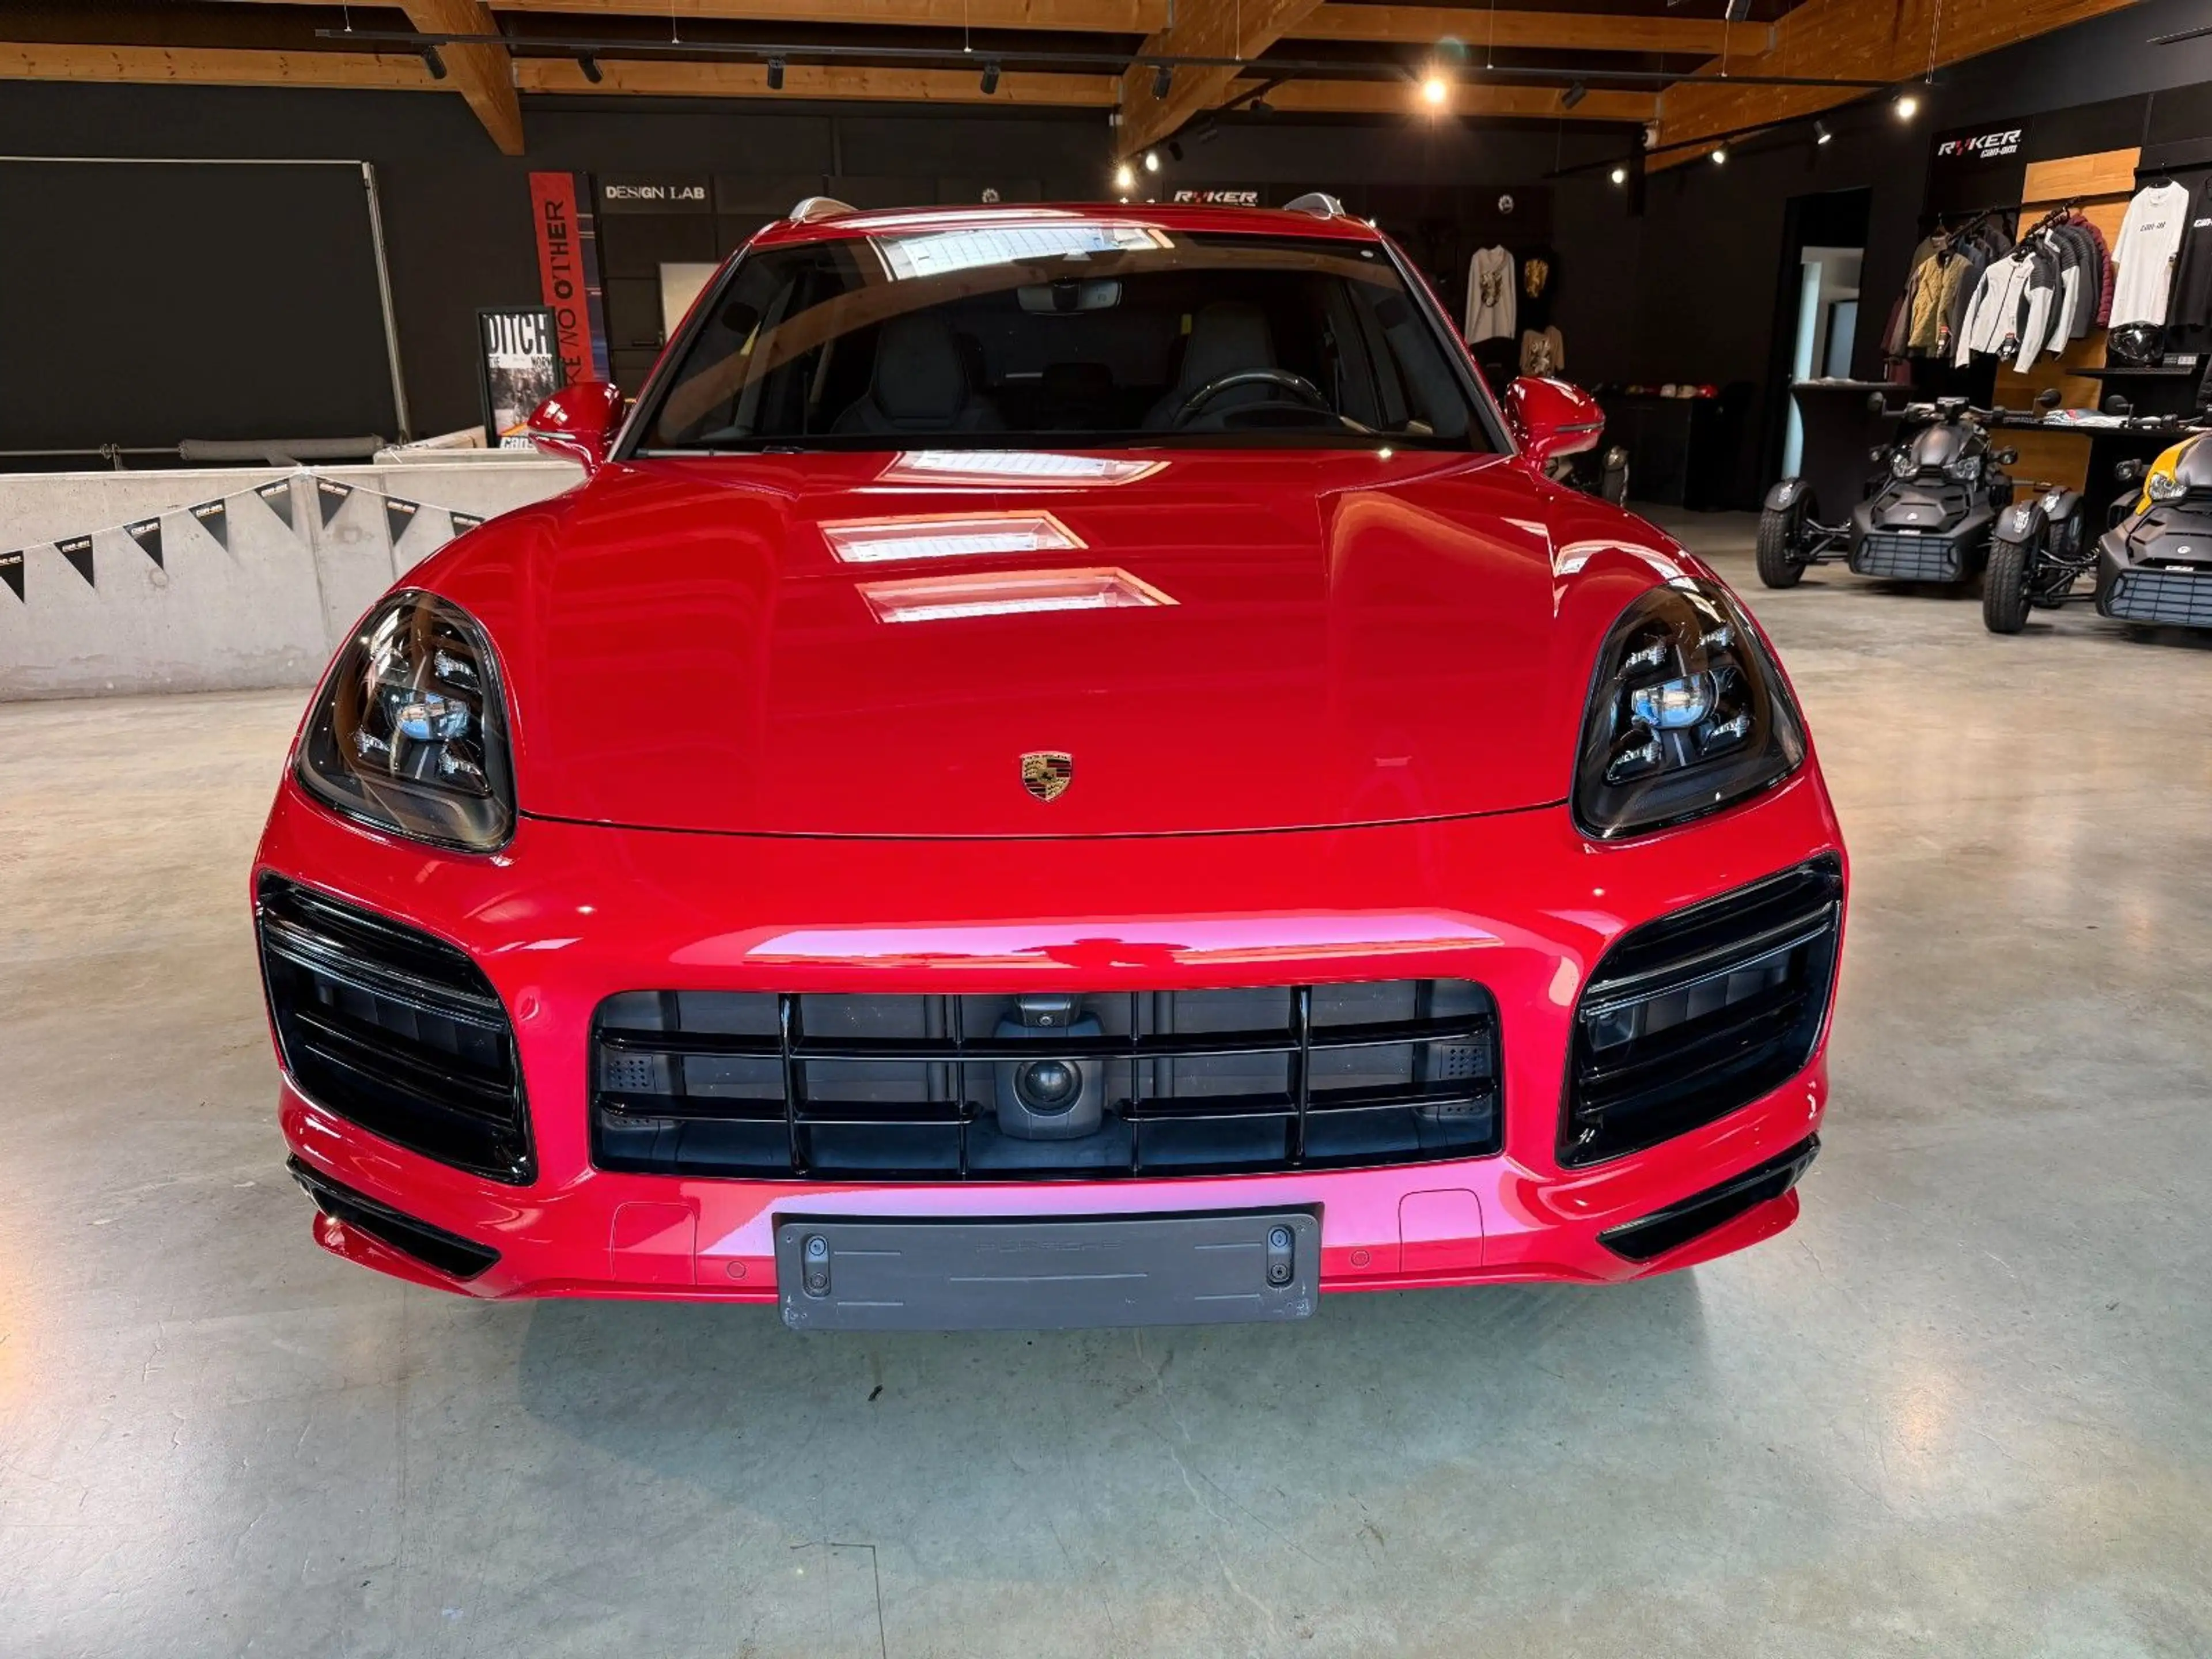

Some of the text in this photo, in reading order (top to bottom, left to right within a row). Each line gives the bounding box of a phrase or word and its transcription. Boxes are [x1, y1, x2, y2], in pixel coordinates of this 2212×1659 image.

[1938, 130, 2021, 156] RYKER
[605, 186, 705, 199] DESIGN LAB
[1173, 190, 1259, 203] RYKER
[545, 200, 573, 299] OTHER
[484, 315, 549, 354] DITCH
[558, 308, 579, 347] NO
